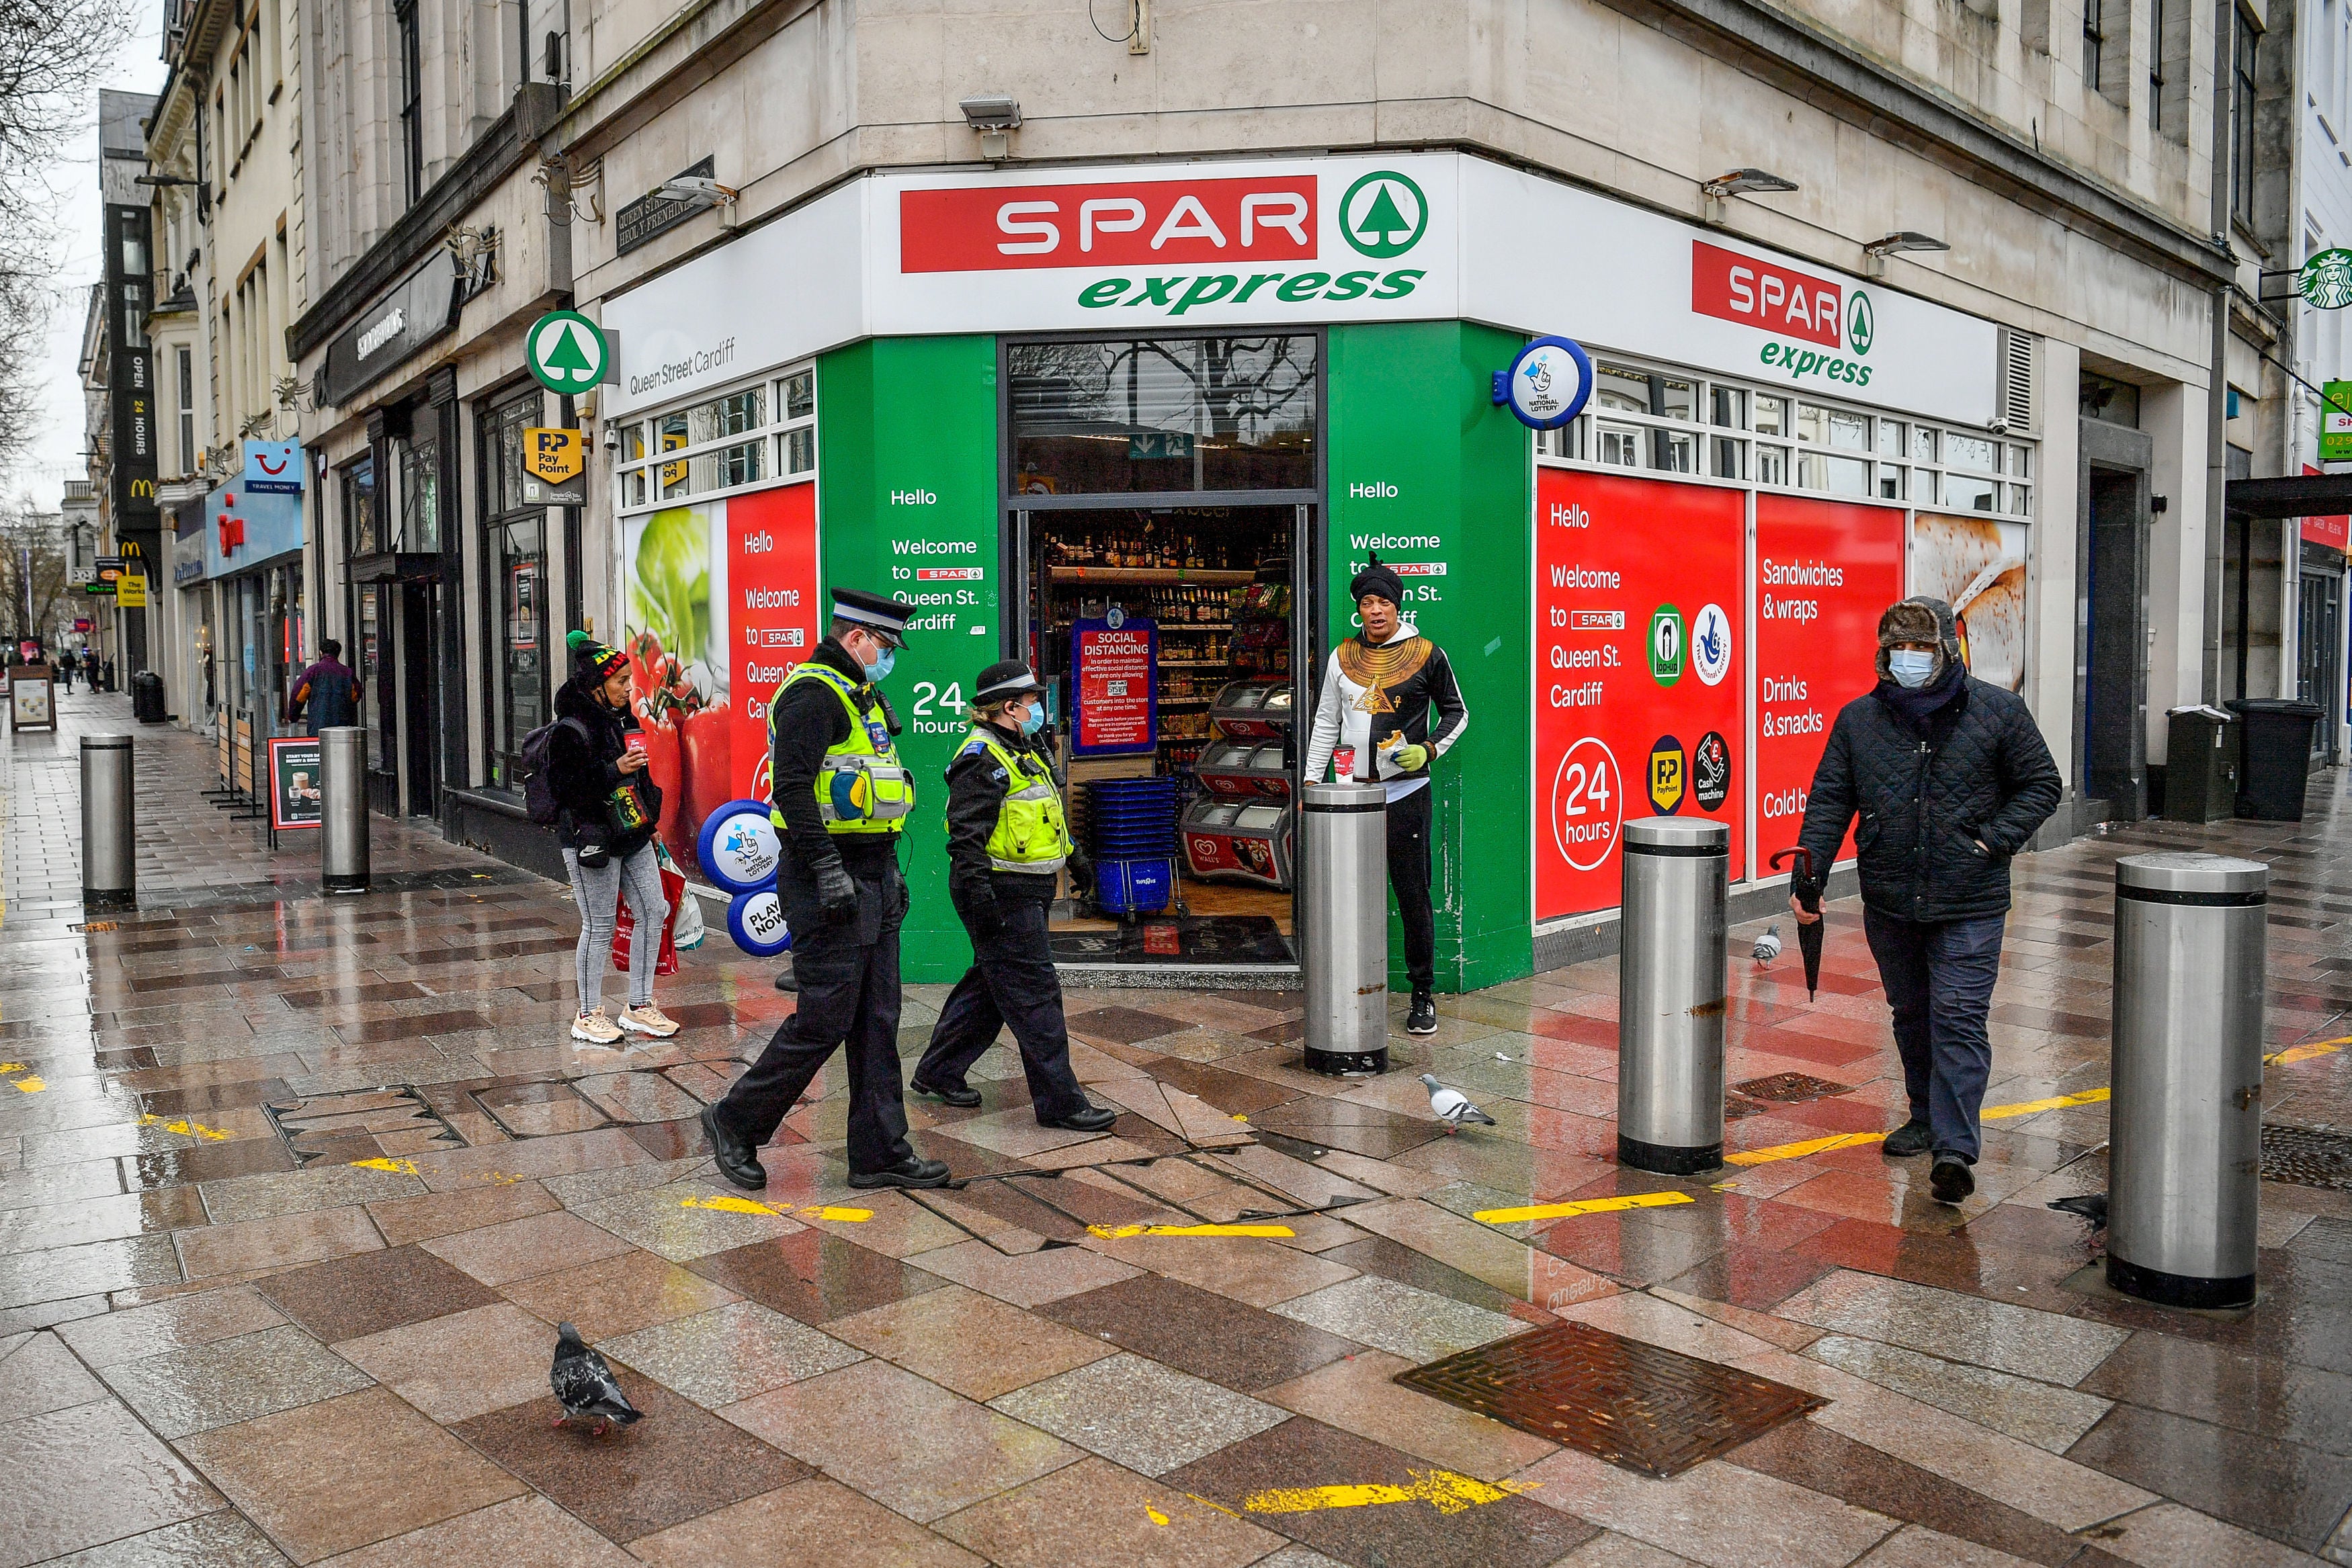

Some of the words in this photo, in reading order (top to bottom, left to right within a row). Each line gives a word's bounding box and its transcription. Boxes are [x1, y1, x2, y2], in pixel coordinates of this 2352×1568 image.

[619, 204, 644, 229] QUEEN
[996, 191, 1308, 255] SPAR
[1077, 269, 1427, 315] express
[1729, 265, 1838, 337] SPAR
[134, 356, 144, 388] OPEN
[630, 371, 660, 396] Queen
[662, 356, 692, 385] Street
[695, 337, 735, 374] Cardiff
[1760, 342, 1873, 386] express
[134, 400, 144, 413] 24
[135, 417, 146, 455] HOURS
[538, 453, 559, 465] Pay
[538, 464, 570, 474] Point
[892, 488, 937, 505] Hello
[1350, 482, 1398, 498] Hello
[1550, 503, 1589, 529] Hello
[744, 529, 773, 555] Hello
[892, 539, 977, 555] Welcome
[1350, 533, 1440, 550] Welcome
[892, 565, 911, 580] to
[929, 570, 967, 578] SPAR
[1550, 564, 1621, 589] Welcome
[1763, 558, 1843, 587] Sandwiches
[745, 585, 800, 609] Welcome
[892, 590, 952, 605] Queen
[956, 589, 979, 605] St.
[1418, 585, 1442, 601] St.
[1550, 605, 1566, 627] to
[1581, 614, 1613, 625] SPAR
[1763, 593, 1775, 619] &
[1777, 599, 1818, 626] wraps
[904, 613, 957, 630] ardiff
[746, 625, 758, 645] to
[769, 632, 793, 643] SPAR
[1098, 633, 1136, 643] SOCIAL
[1085, 644, 1148, 655] DISTANCING
[1550, 645, 1600, 669] Queen
[1603, 644, 1622, 668] St.
[747, 661, 784, 683] Queen
[1656, 661, 1678, 674] top-up
[913, 681, 966, 715] 24
[1550, 681, 1603, 708] Cardiff
[1763, 674, 1807, 703] Drinks
[913, 717, 968, 734] hours
[1763, 711, 1775, 738] &
[1777, 707, 1823, 736] snacks
[1565, 761, 1611, 816] 24
[1657, 785, 1678, 795] PayPoint
[1698, 779, 1714, 789] Cash
[1698, 790, 1724, 801] machine
[1763, 787, 1796, 818] Cold
[1566, 820, 1610, 844] hours
[745, 855, 773, 874] NATIONAL
[749, 860, 773, 877] LOTTERY
[751, 854, 763, 864] THE
[1199, 855, 1220, 863] WALL'S
[749, 900, 780, 926] PLAY
[755, 913, 784, 937] NOW
